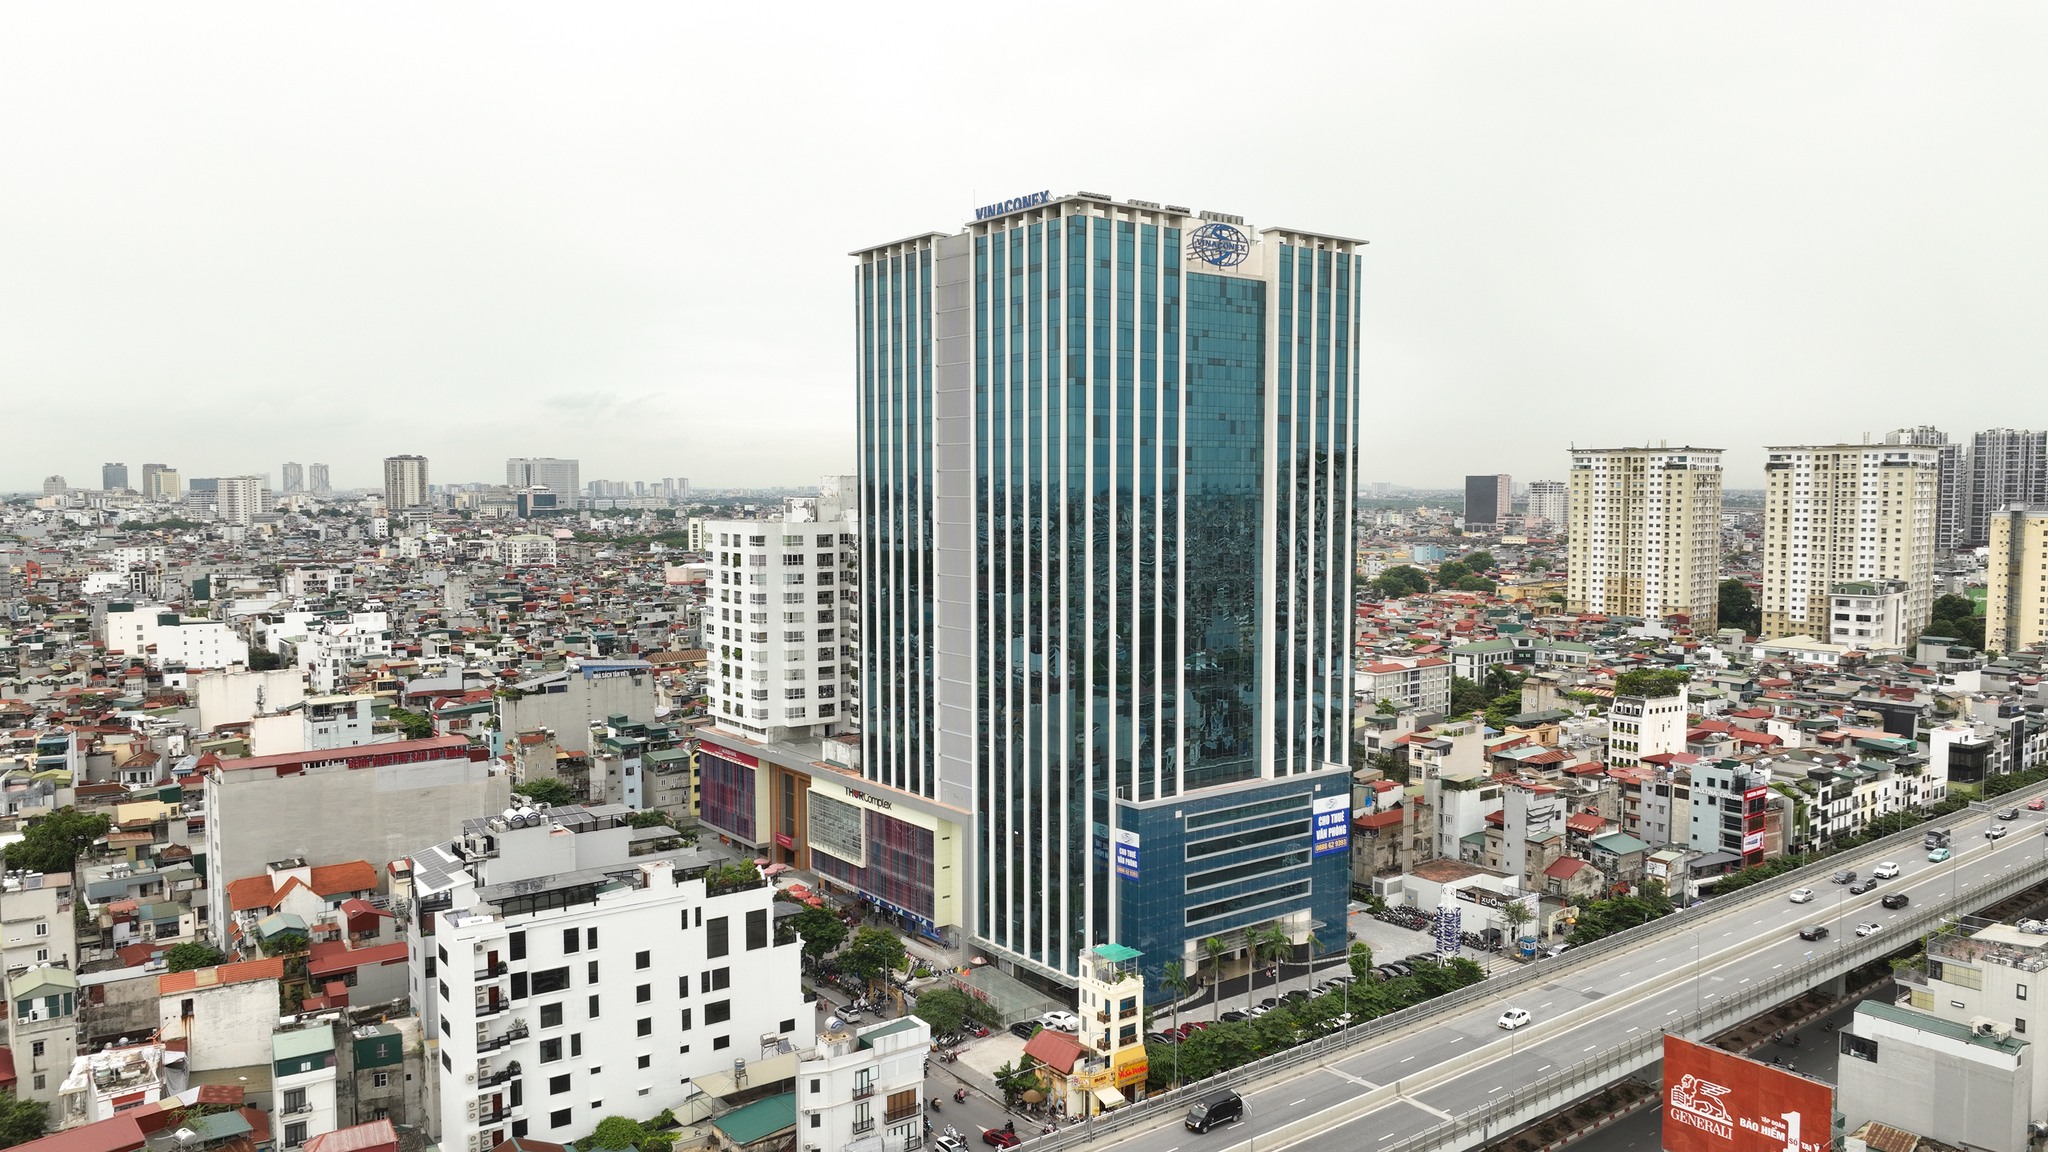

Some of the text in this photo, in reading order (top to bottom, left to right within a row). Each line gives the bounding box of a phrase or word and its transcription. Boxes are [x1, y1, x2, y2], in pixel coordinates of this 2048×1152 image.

[975, 190, 1050, 220] VINACONEX
[1196, 238, 1246, 252] VINACONEX
[1720, 790, 1744, 801] ENGLISH
[1318, 810, 1345, 827] CHO THUÊ
[1328, 824, 1347, 838] PHÒNG
[1670, 1107, 1733, 1141] GENERALI
[1740, 1117, 1786, 1142] BẢO HIỂM
